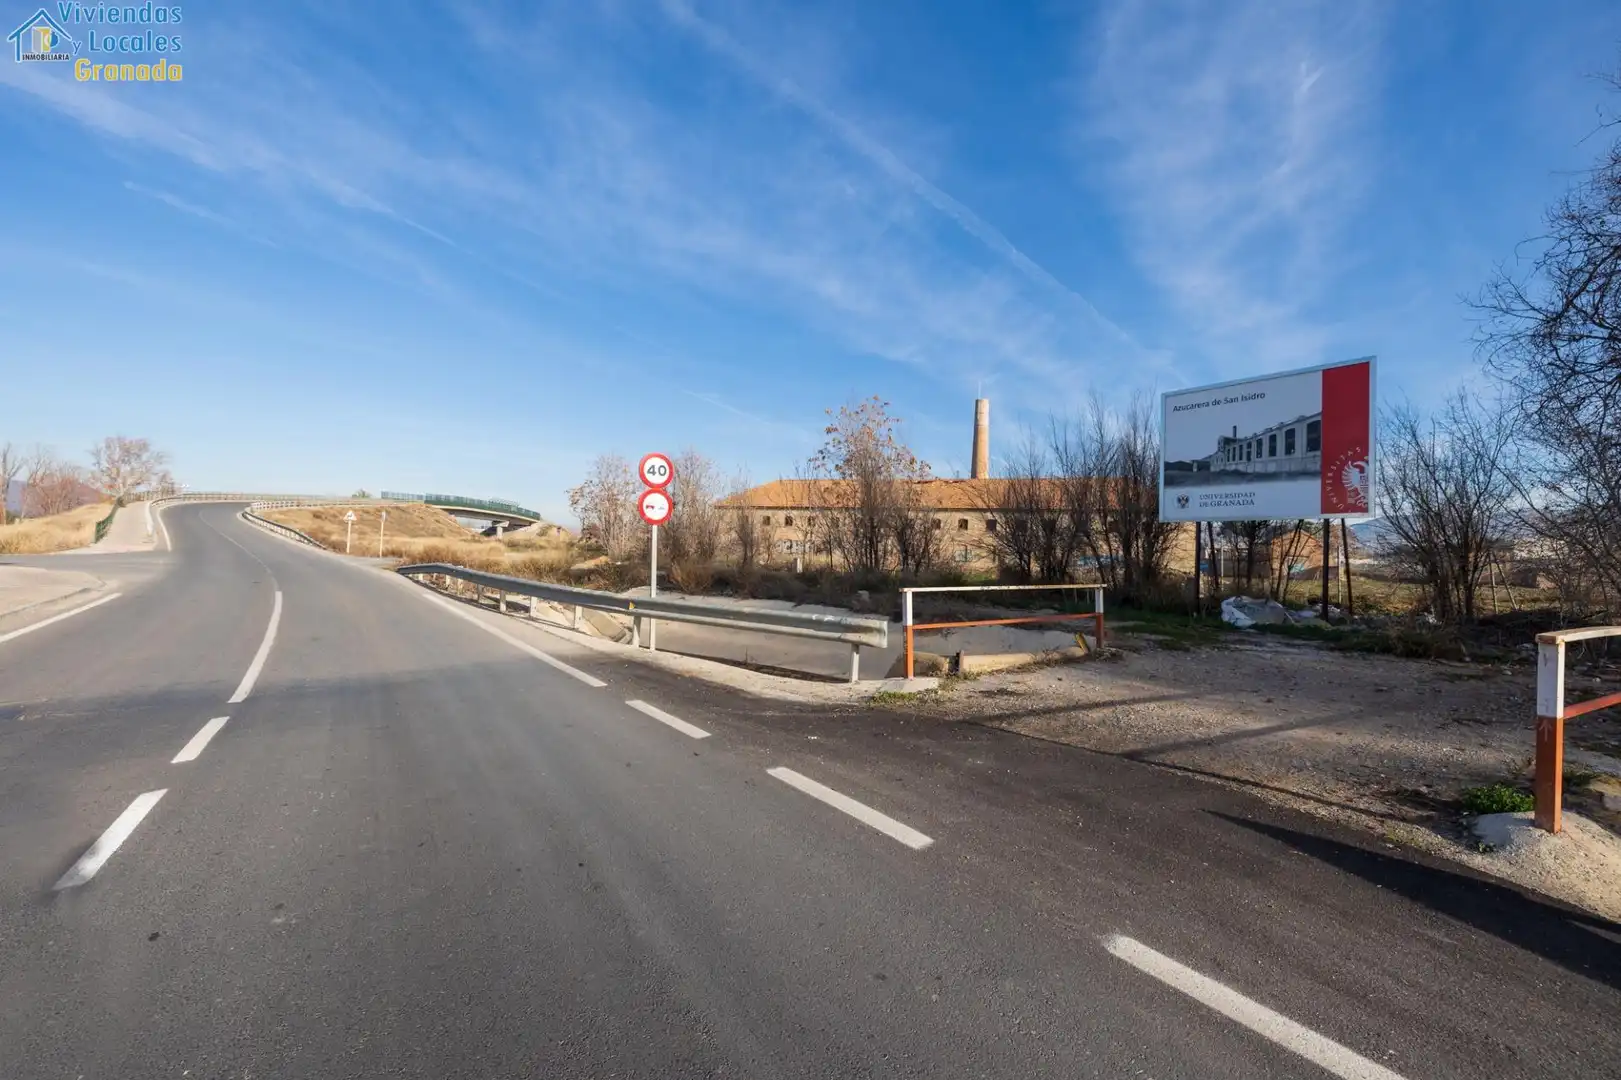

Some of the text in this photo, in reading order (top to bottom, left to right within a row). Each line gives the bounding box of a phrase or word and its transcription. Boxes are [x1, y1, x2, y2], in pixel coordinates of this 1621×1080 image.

[1172, 391, 1266, 413] Azucarera de San Isidro
[647, 464, 667, 476] 40
[1199, 491, 1256, 500] UNIVERSIDAD
[1199, 498, 1256, 508] DE GRANADA
